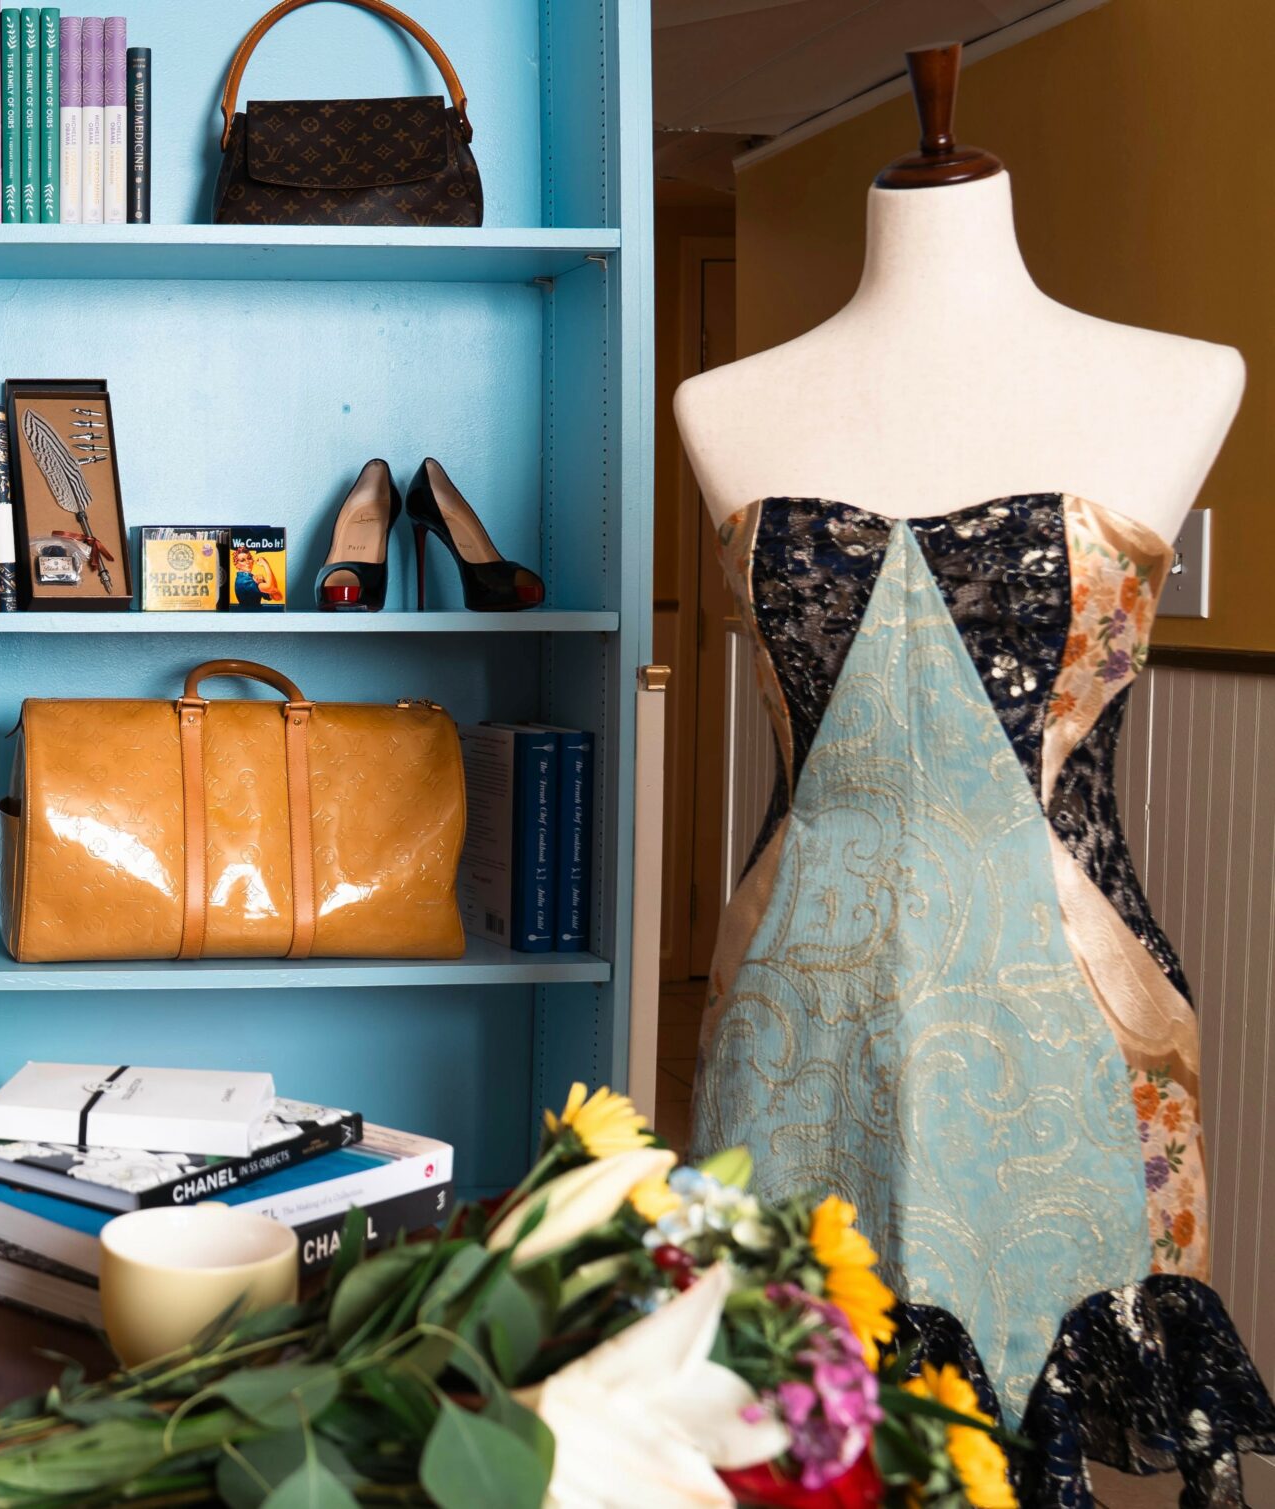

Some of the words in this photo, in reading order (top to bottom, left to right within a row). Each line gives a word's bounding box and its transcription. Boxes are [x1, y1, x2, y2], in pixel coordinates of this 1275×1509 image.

[7, 97, 14, 107] OF
[26, 97, 33, 107] OF
[46, 97, 53, 107] OF
[134, 82, 145, 113] WILD
[134, 115, 145, 172] MEDICINE
[232, 538, 245, 548] We
[245, 538, 261, 548] Can
[261, 539, 273, 548] Do
[274, 538, 284, 548] It!
[150, 572, 214, 584] HIP-HOP
[152, 585, 210, 597] TRIVIA
[540, 758, 548, 774] The
[575, 758, 583, 773] The
[539, 777, 548, 805] French
[574, 777, 582, 804] French
[538, 806, 547, 826] Chef
[573, 806, 582, 825] Chef
[538, 827, 547, 863] Cookbook
[573, 827, 582, 863] Cookbook
[537, 885, 545, 907] Julia
[572, 885, 580, 906] Julia
[537, 910, 545, 930] Child
[572, 909, 580, 930] Child
[172, 1166, 238, 1203] CHANEL
[238, 1165, 248, 1177] IN
[259, 1150, 290, 1169] OBJECTS
[303, 1216, 378, 1264] CHAL
